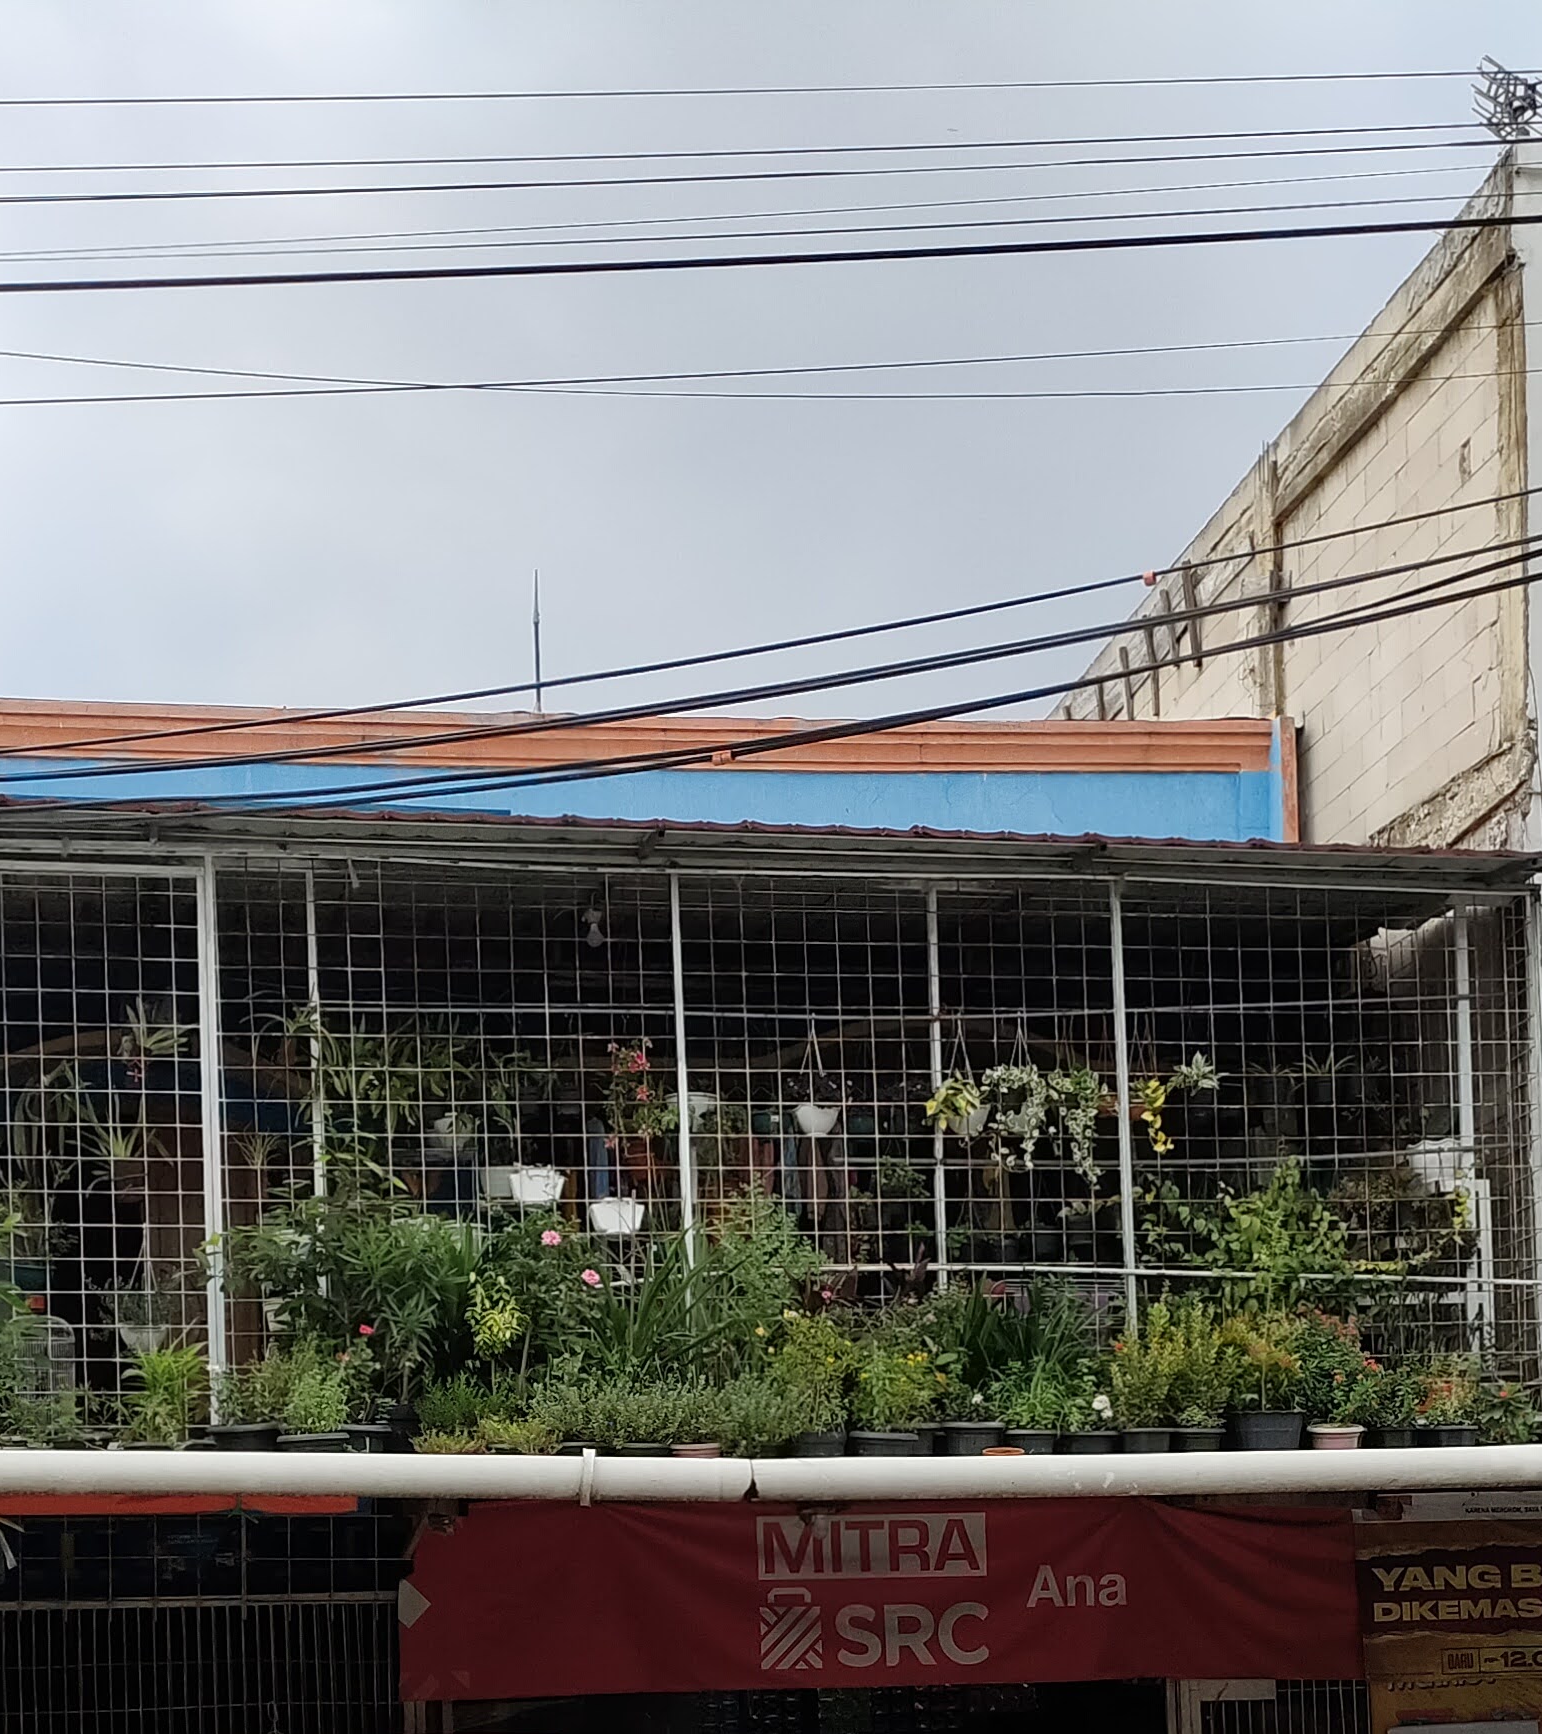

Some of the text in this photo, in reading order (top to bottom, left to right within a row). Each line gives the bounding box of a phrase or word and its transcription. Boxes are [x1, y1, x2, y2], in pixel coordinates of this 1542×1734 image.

[763, 1520, 1128, 1609] MITRA Ana
[1371, 1563, 1503, 1593] YANG
[835, 1602, 990, 1667] SRC
